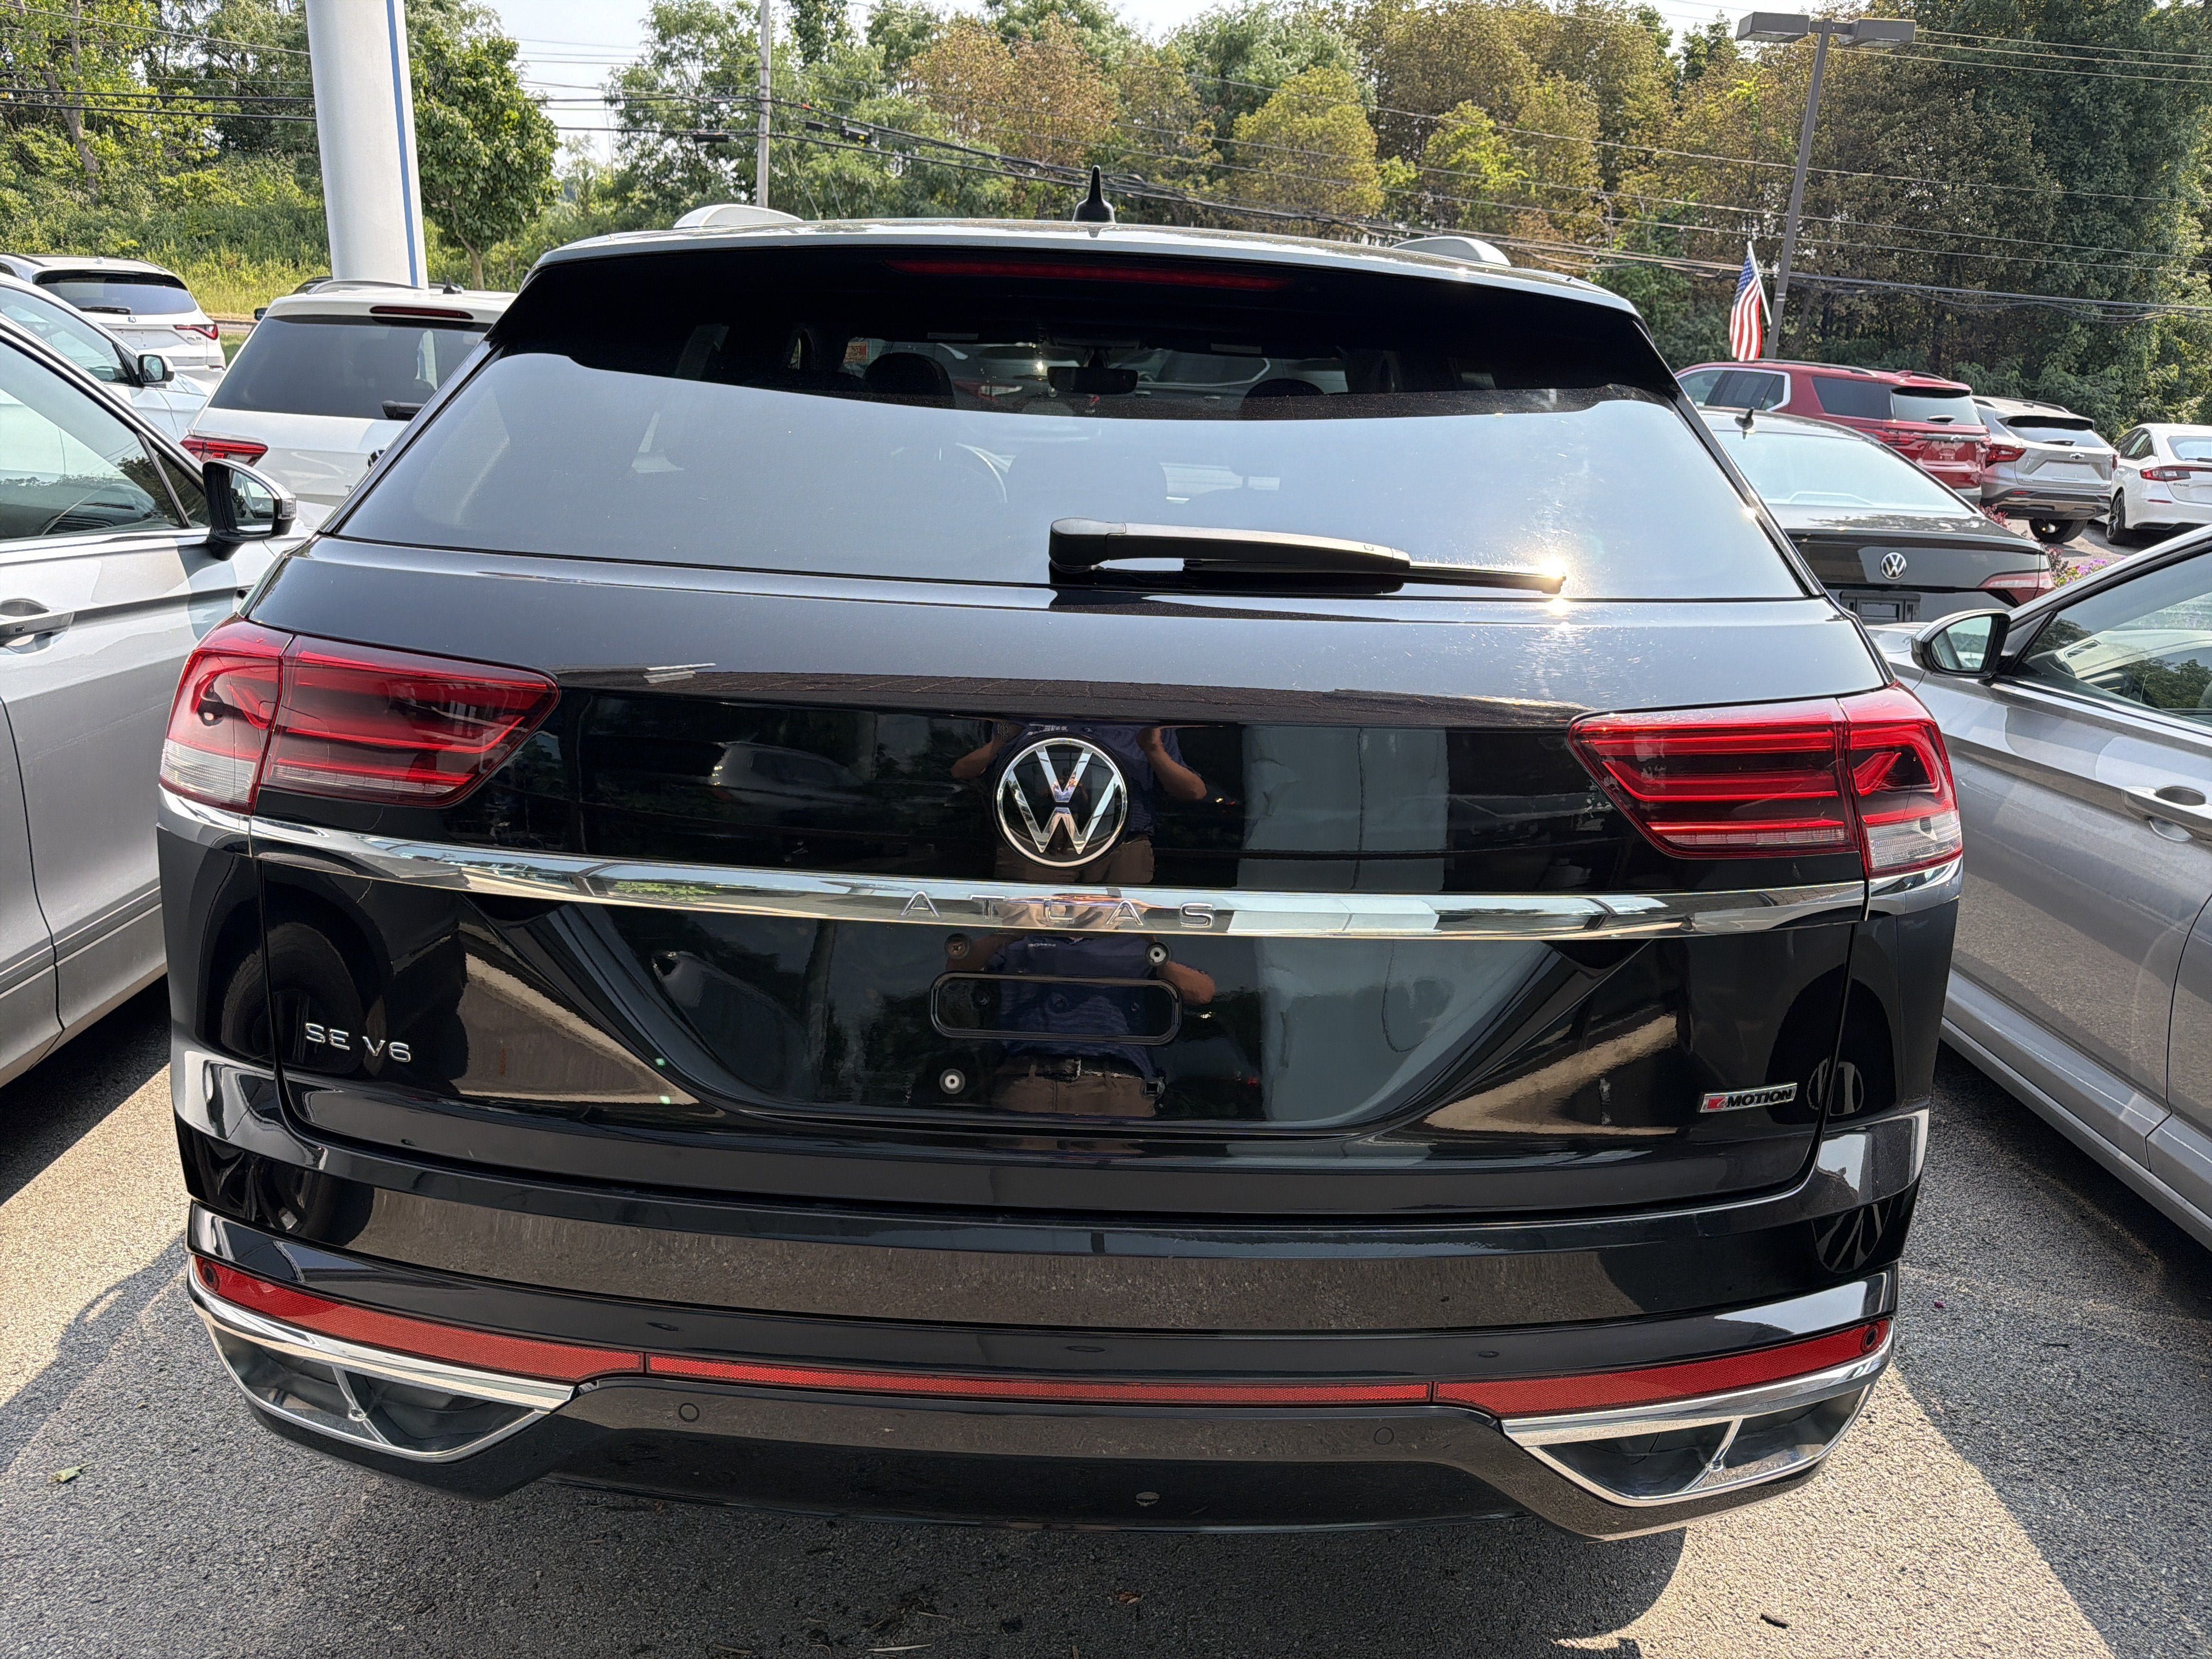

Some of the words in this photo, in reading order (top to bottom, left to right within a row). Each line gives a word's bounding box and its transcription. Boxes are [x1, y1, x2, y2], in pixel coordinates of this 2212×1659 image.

[900, 890, 1215, 928] ATLAS
[305, 1022, 351, 1051] SE
[362, 1036, 411, 1063] V6
